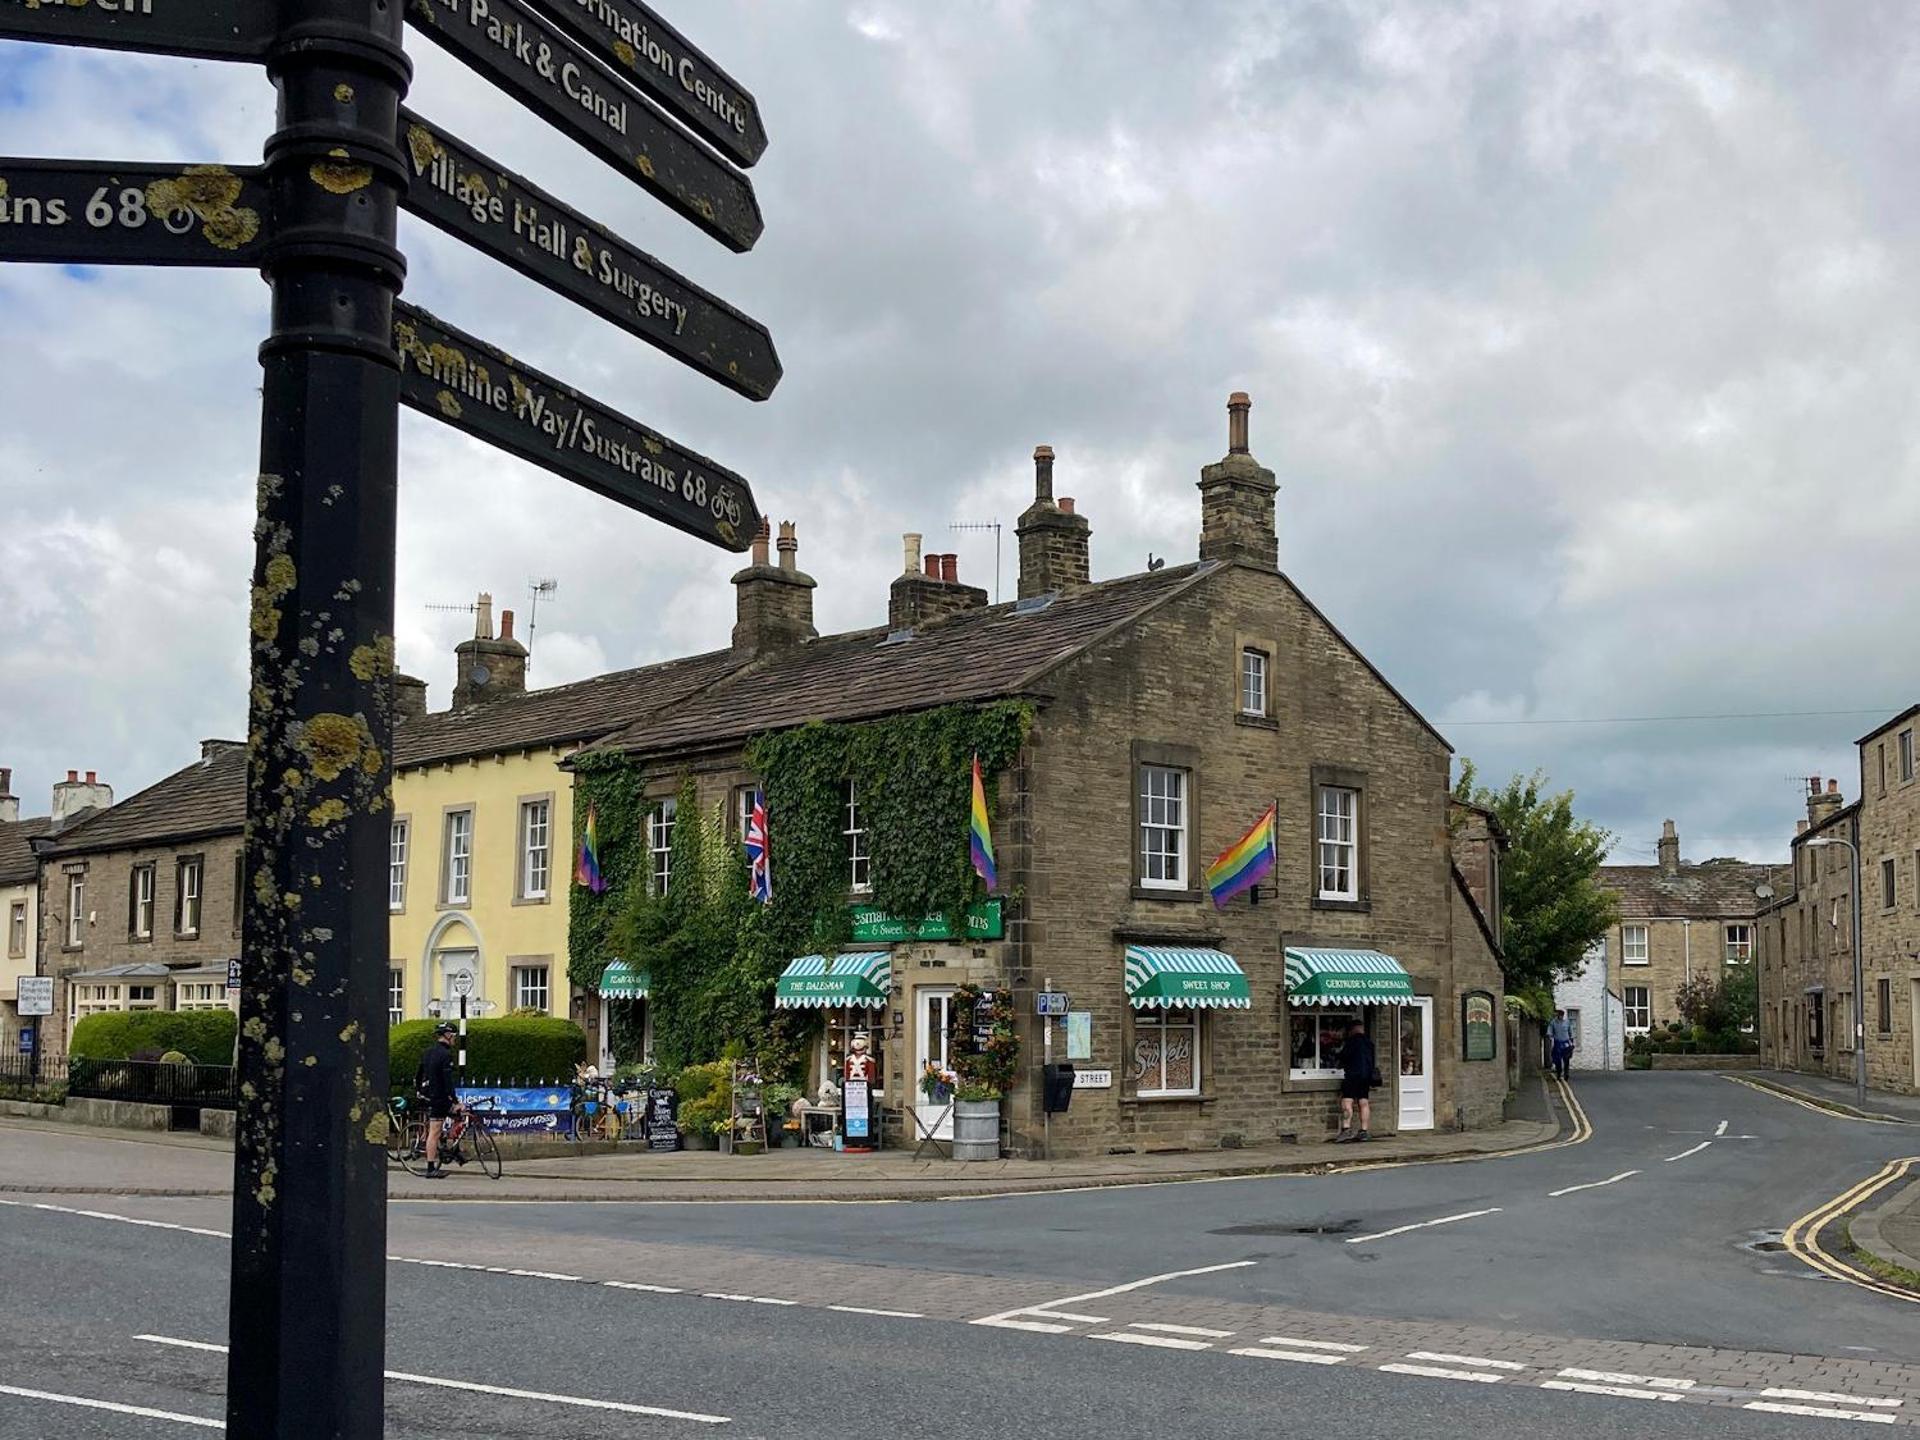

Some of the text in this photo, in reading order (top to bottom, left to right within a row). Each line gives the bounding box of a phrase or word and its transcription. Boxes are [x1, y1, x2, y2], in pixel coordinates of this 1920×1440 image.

[471, 0, 627, 135] Park & Canal
[679, 58, 745, 133] Centre
[85, 187, 147, 228] 68
[407, 124, 687, 335] Village Hall & Surgery
[682, 459, 707, 507] 68
[790, 981, 845, 990] THE DALESMAN
[1182, 980, 1231, 990] SWEET SHOP
[1080, 1074, 1107, 1084] STREET
[1135, 1037, 1190, 1080] Swets
